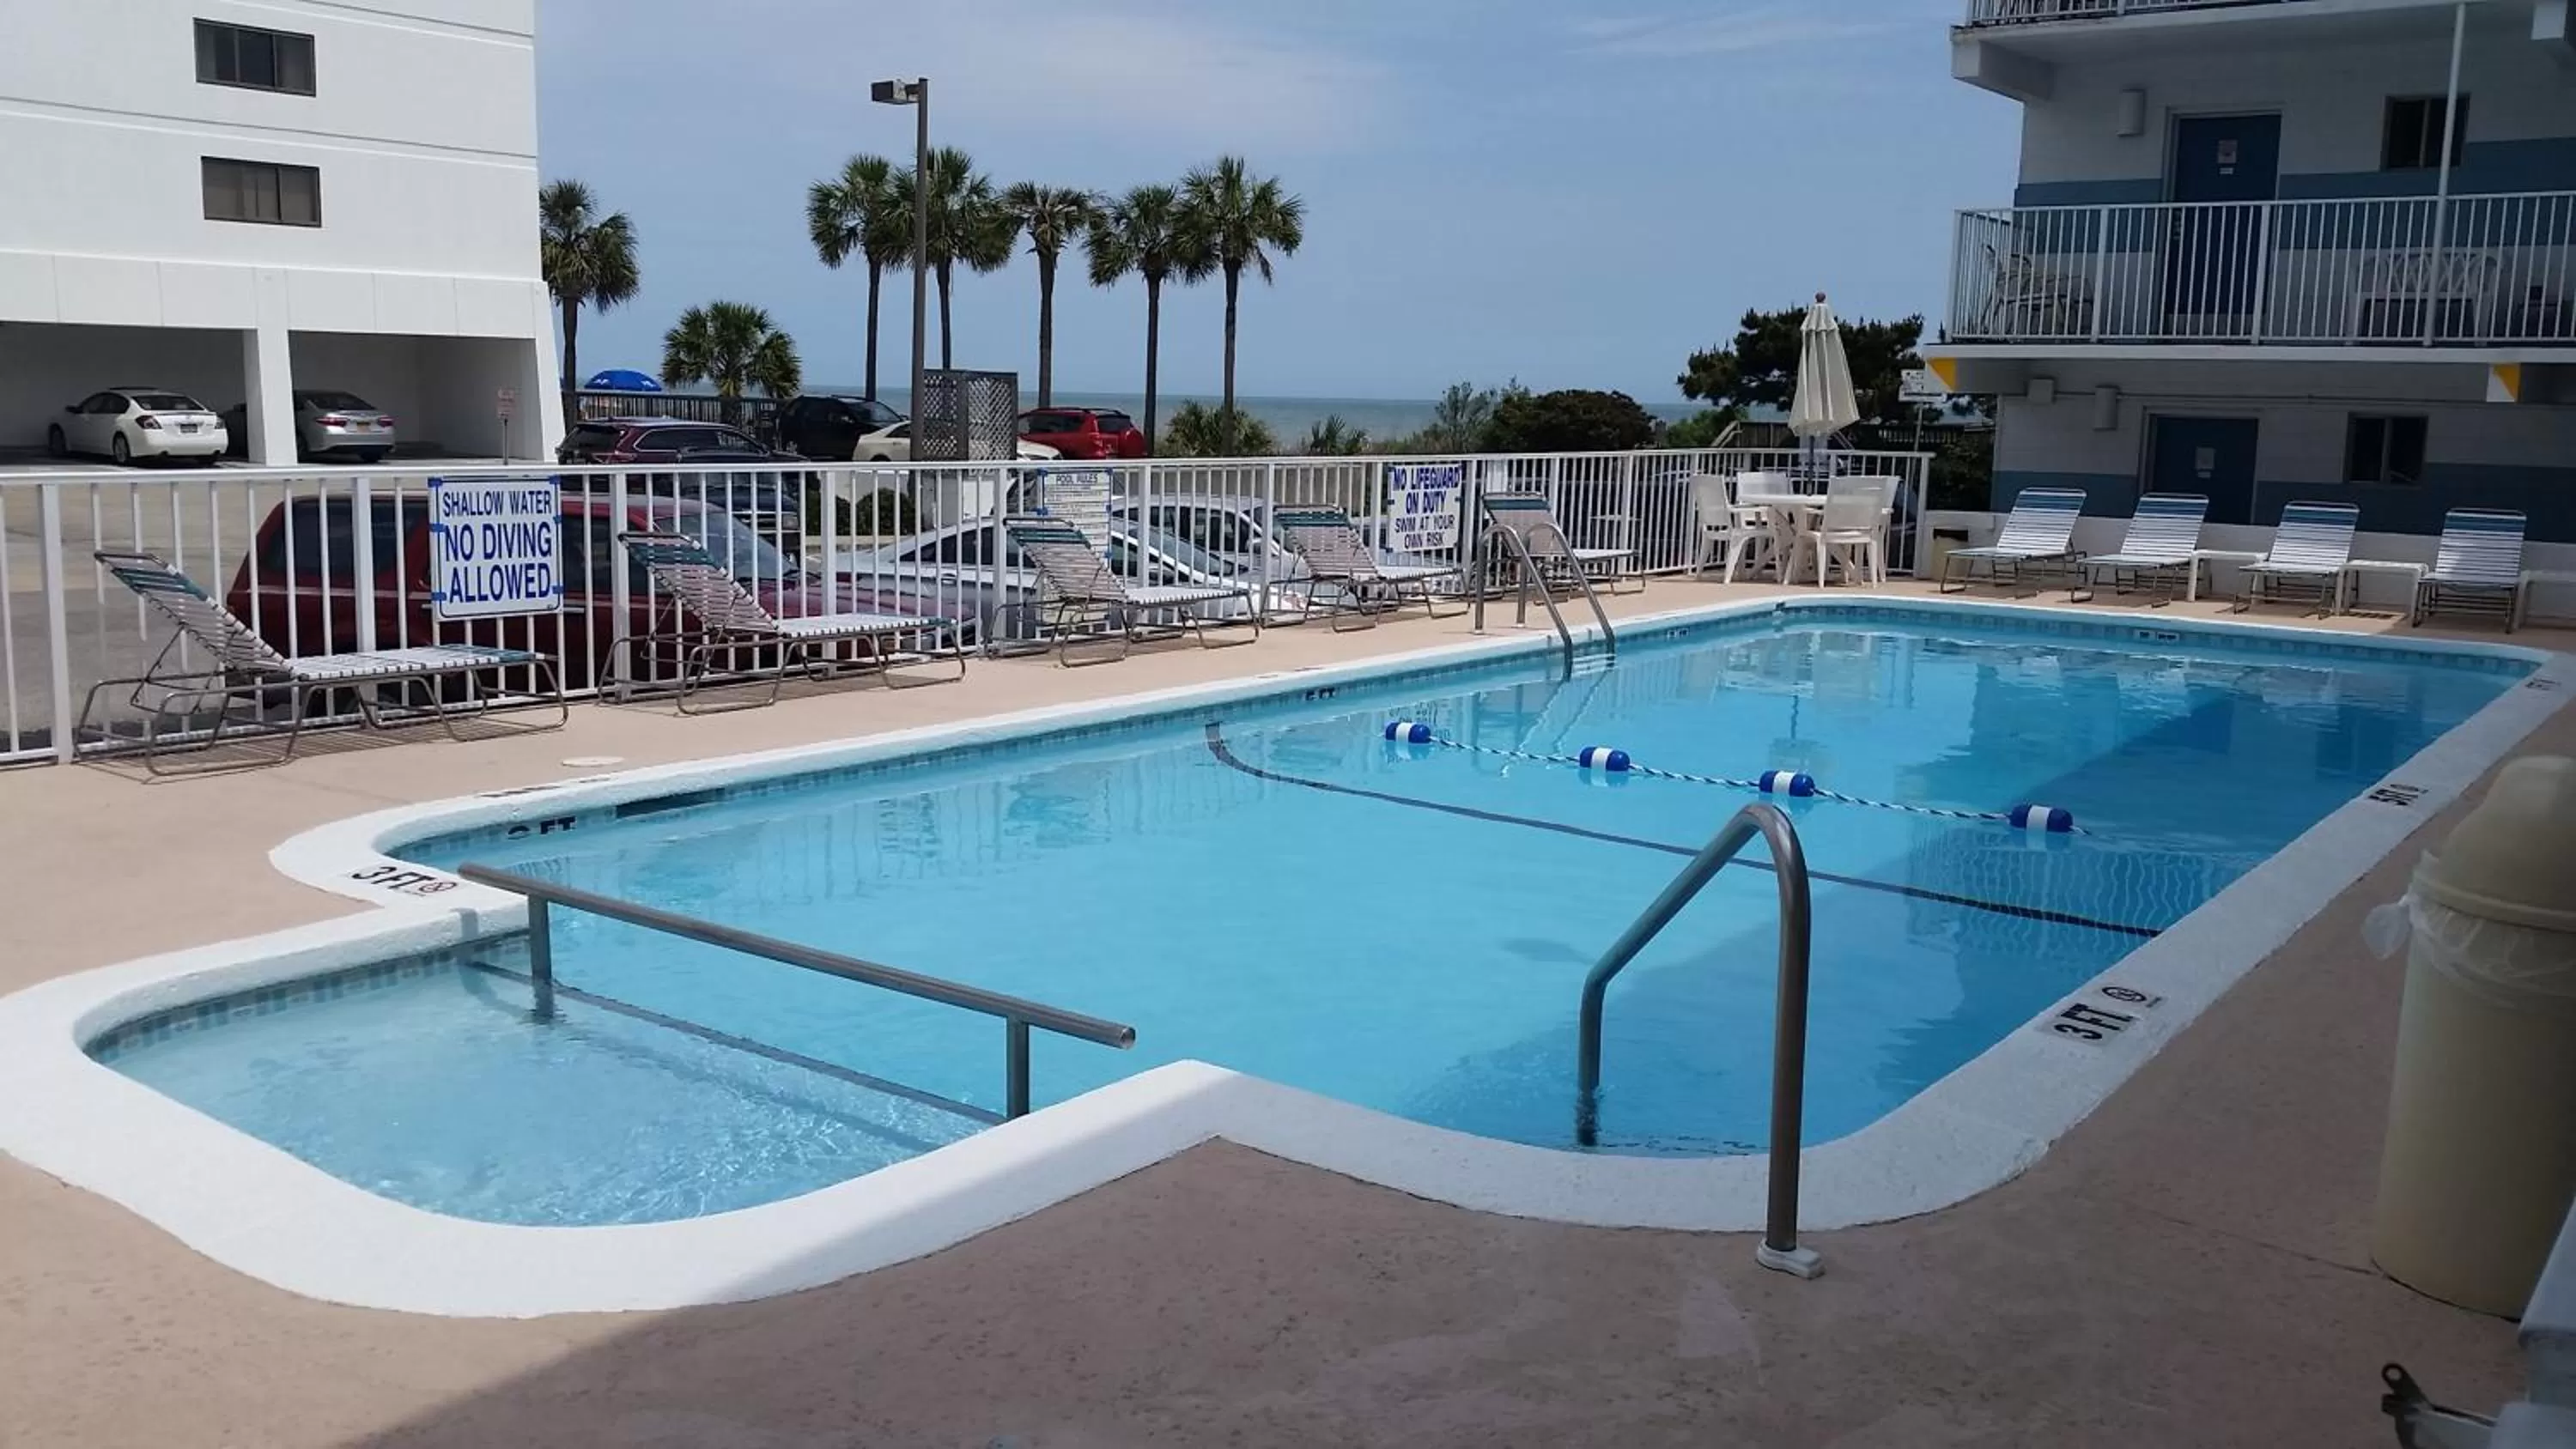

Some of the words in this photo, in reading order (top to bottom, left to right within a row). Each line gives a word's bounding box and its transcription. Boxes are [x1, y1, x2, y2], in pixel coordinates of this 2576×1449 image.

[1393, 467, 1407, 491] NO
[1411, 466, 1461, 490] LIFEGUARD
[442, 490, 504, 518] SHALLOW
[509, 490, 552, 515] WATER
[1406, 492, 1419, 515] ON
[1422, 490, 1447, 514] DUTY
[1394, 517, 1416, 533] SWIM
[1419, 516, 1430, 530] AT
[1433, 514, 1455, 530] YOUR
[446, 523, 475, 562] NO
[483, 521, 552, 561] DIVING
[1404, 533, 1423, 549] OWN
[1426, 531, 1444, 547] RISK
[449, 562, 551, 604] ALLOWED
[2054, 1023, 2103, 1040] 3
